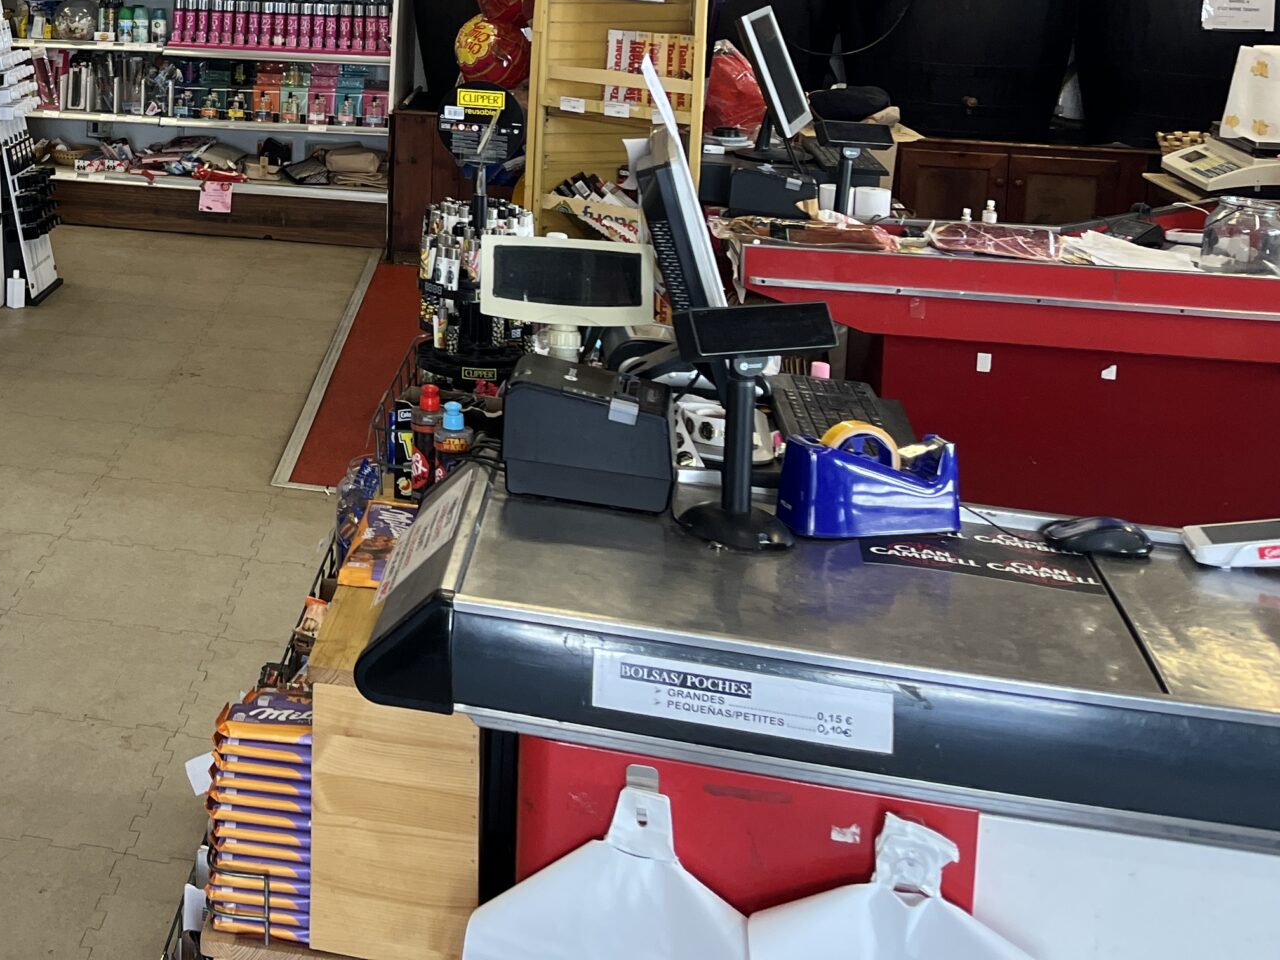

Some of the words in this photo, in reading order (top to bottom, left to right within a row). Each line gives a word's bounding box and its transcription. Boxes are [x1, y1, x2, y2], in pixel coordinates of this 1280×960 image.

[462, 93, 500, 105] CLIPPER
[464, 107, 498, 116] reusable
[870, 546, 982, 568] CAMPBELL
[894, 544, 950, 557] CLAN
[986, 562, 1102, 586] CAMPBELL
[1010, 562, 1069, 576] CLAN
[619, 663, 684, 687] BOLSAS/
[686, 672, 752, 696] POCHES:
[667, 688, 726, 705] GRANDES
[667, 700, 785, 727] PEQUEÑAS/PETITES
[816, 711, 843, 724] 0,15
